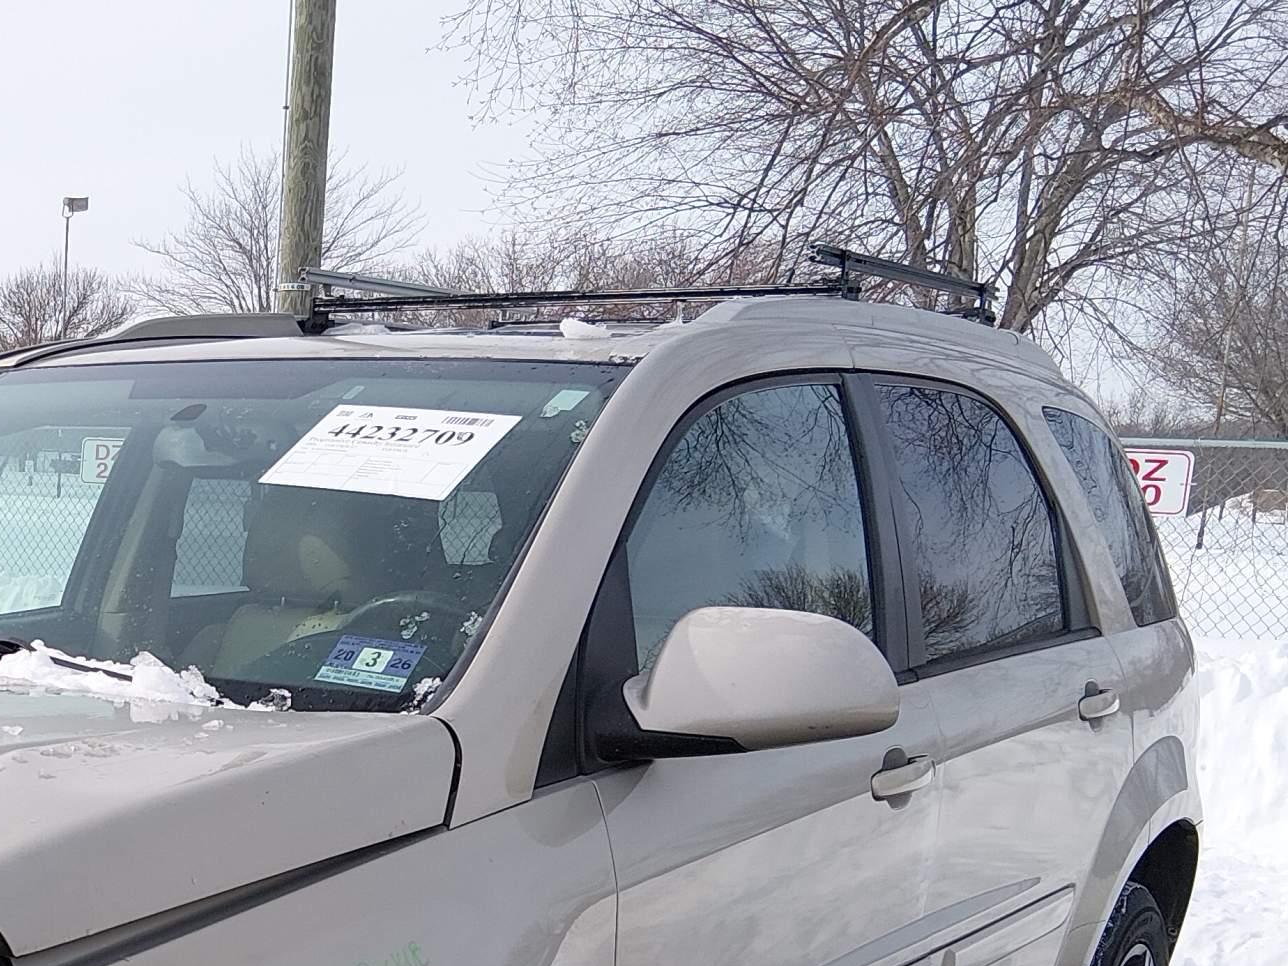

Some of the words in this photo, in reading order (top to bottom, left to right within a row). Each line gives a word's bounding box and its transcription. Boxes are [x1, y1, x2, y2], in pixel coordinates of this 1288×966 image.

[328, 423, 475, 446] 44232709
[95, 462, 109, 479] 2
[1141, 484, 1162, 506] 0
[334, 648, 356, 662] 20
[365, 651, 382, 668] 3
[390, 658, 412, 670] 26
